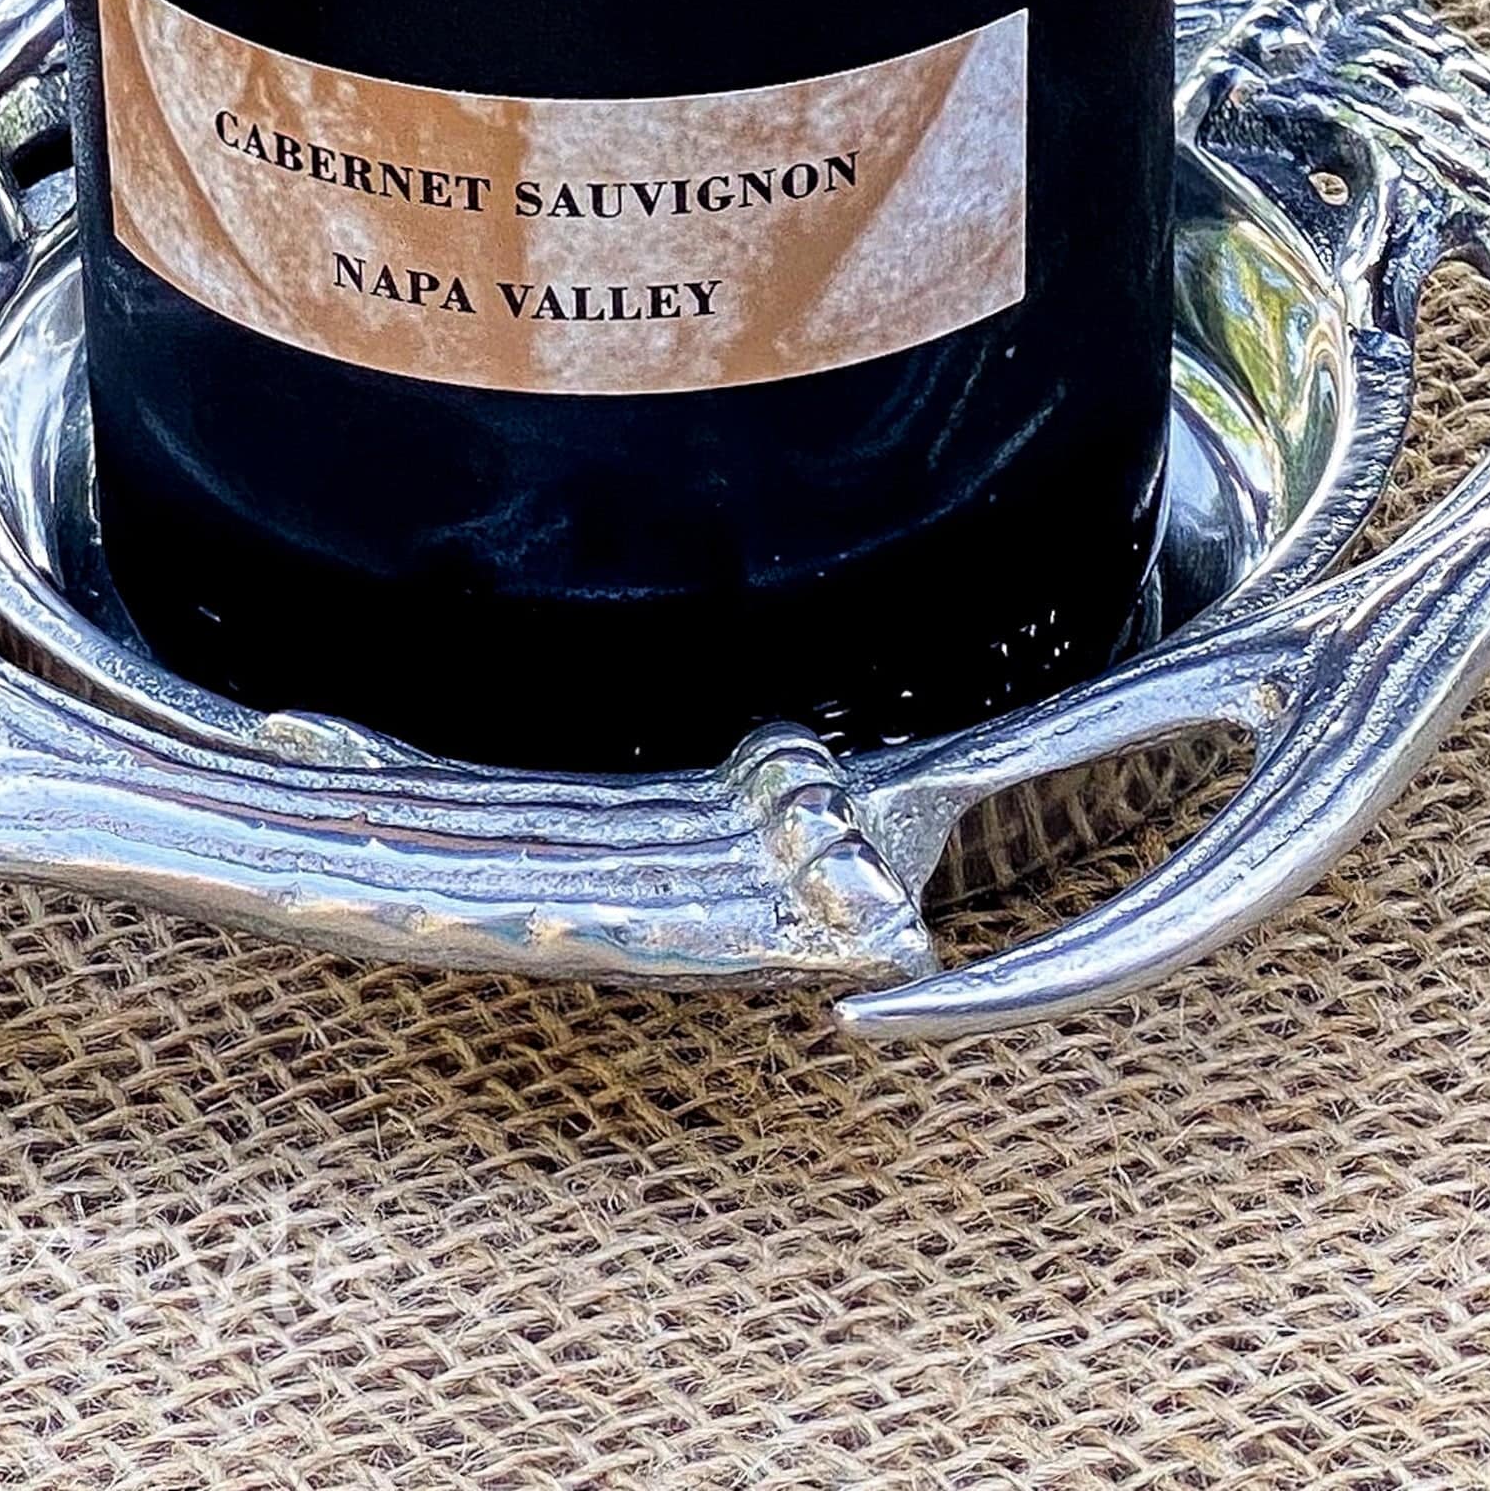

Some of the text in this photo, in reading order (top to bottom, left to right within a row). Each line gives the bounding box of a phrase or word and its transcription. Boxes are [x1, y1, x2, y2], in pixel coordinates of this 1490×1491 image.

[214, 109, 860, 219] CABERNET SAUVIGNON
[332, 251, 722, 322] NAPA VALLEY
